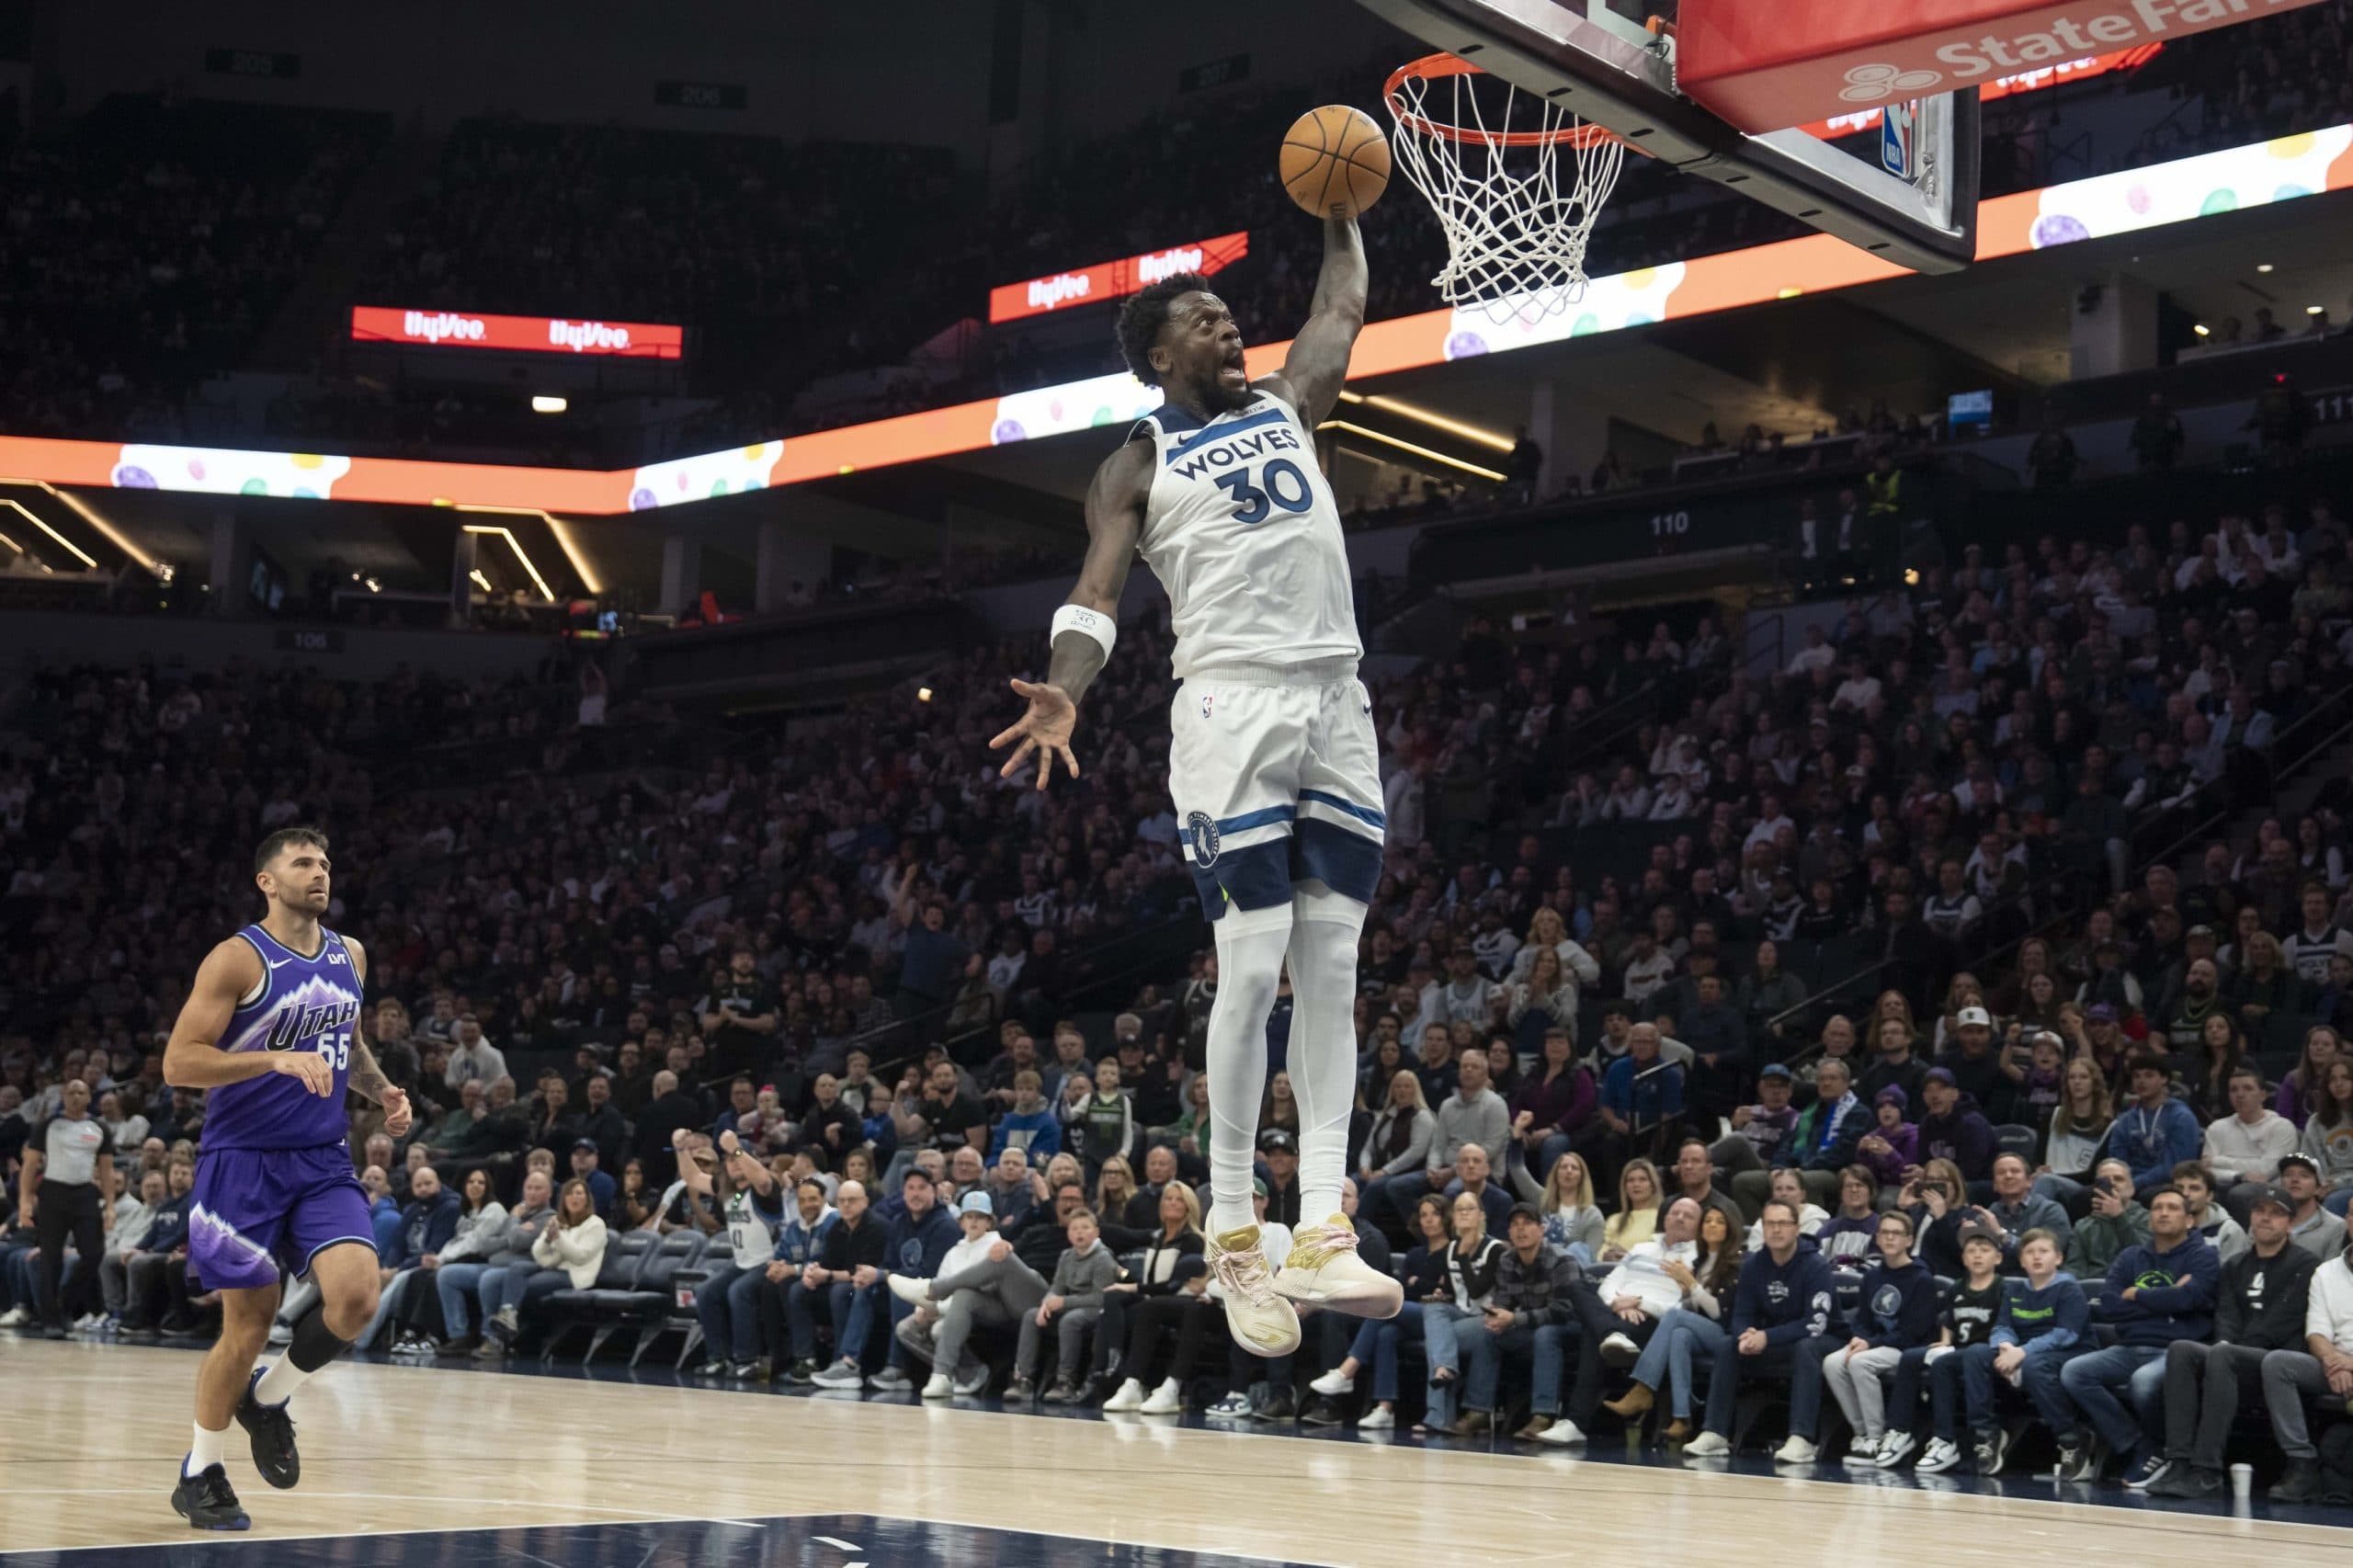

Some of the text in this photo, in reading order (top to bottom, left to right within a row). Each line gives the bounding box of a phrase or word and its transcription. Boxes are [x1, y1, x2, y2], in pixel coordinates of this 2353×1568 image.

[1174, 429, 1300, 481] WOLVES
[1213, 458, 1313, 524] 30
[1652, 511, 1688, 536] 110
[327, 954, 347, 964] LVT
[266, 999, 359, 1051] UTAH
[317, 1033, 351, 1071] 55
